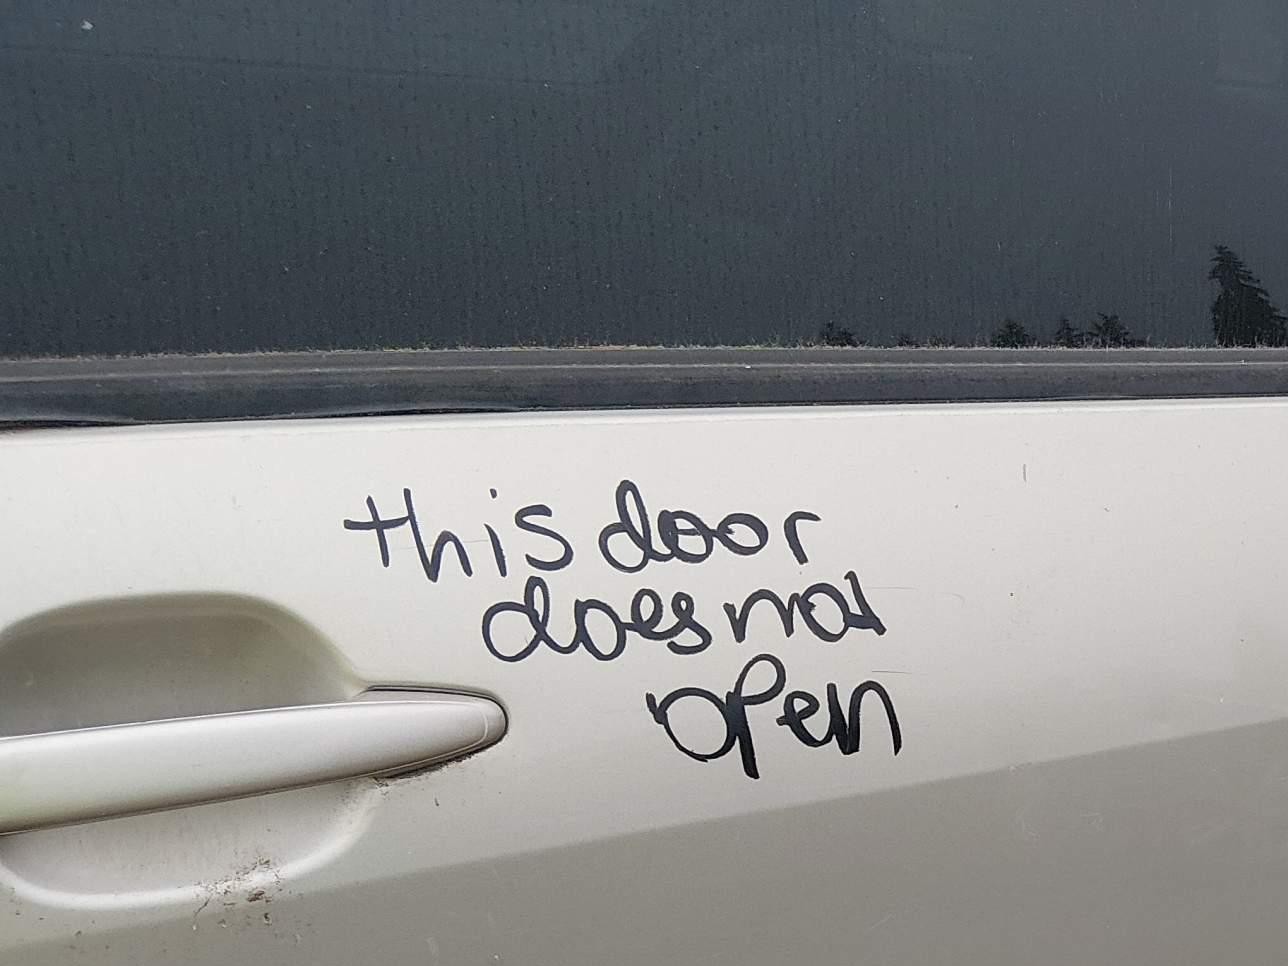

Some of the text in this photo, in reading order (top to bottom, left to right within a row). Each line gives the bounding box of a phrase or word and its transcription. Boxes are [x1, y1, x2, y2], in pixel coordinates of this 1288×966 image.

[343, 479, 822, 581] this door
[481, 575, 713, 663] does
